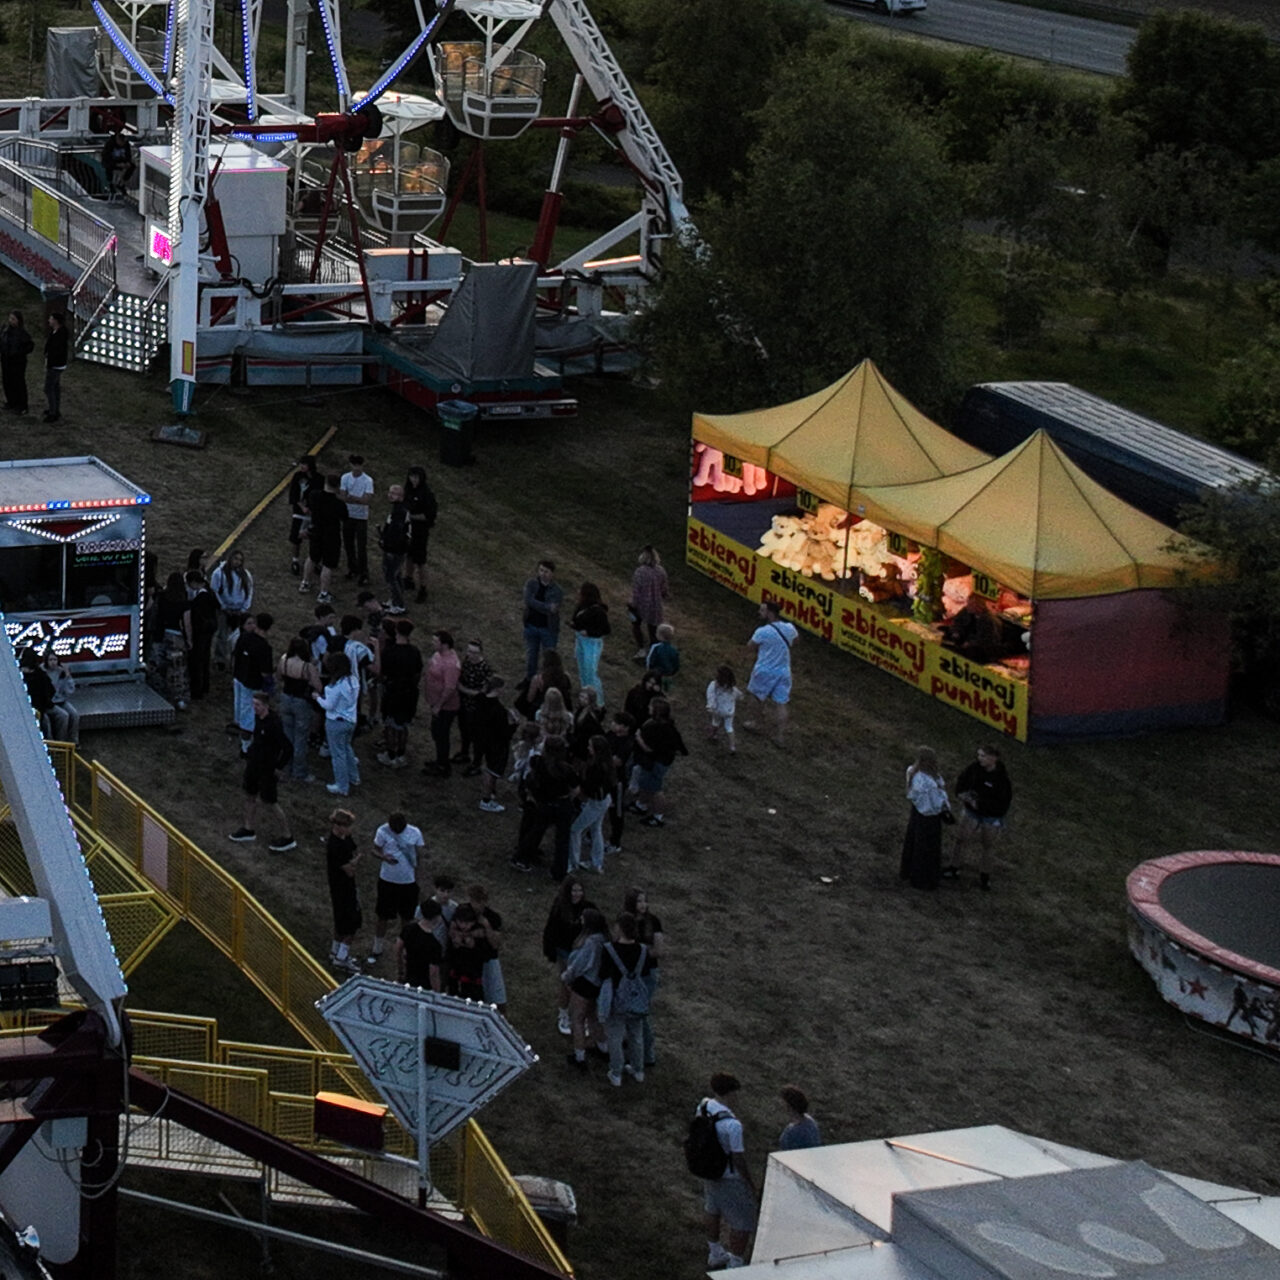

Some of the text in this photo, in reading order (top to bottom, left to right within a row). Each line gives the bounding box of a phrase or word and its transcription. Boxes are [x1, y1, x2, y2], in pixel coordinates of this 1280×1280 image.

[688, 526, 757, 586] zbieraj
[888, 531, 901, 552] 10
[770, 569, 833, 617] zbieraj
[973, 574, 988, 594] 10
[841, 608, 925, 673] zbieraj
[930, 675, 1018, 737] punkty
[939, 656, 1016, 710] zbieraj
